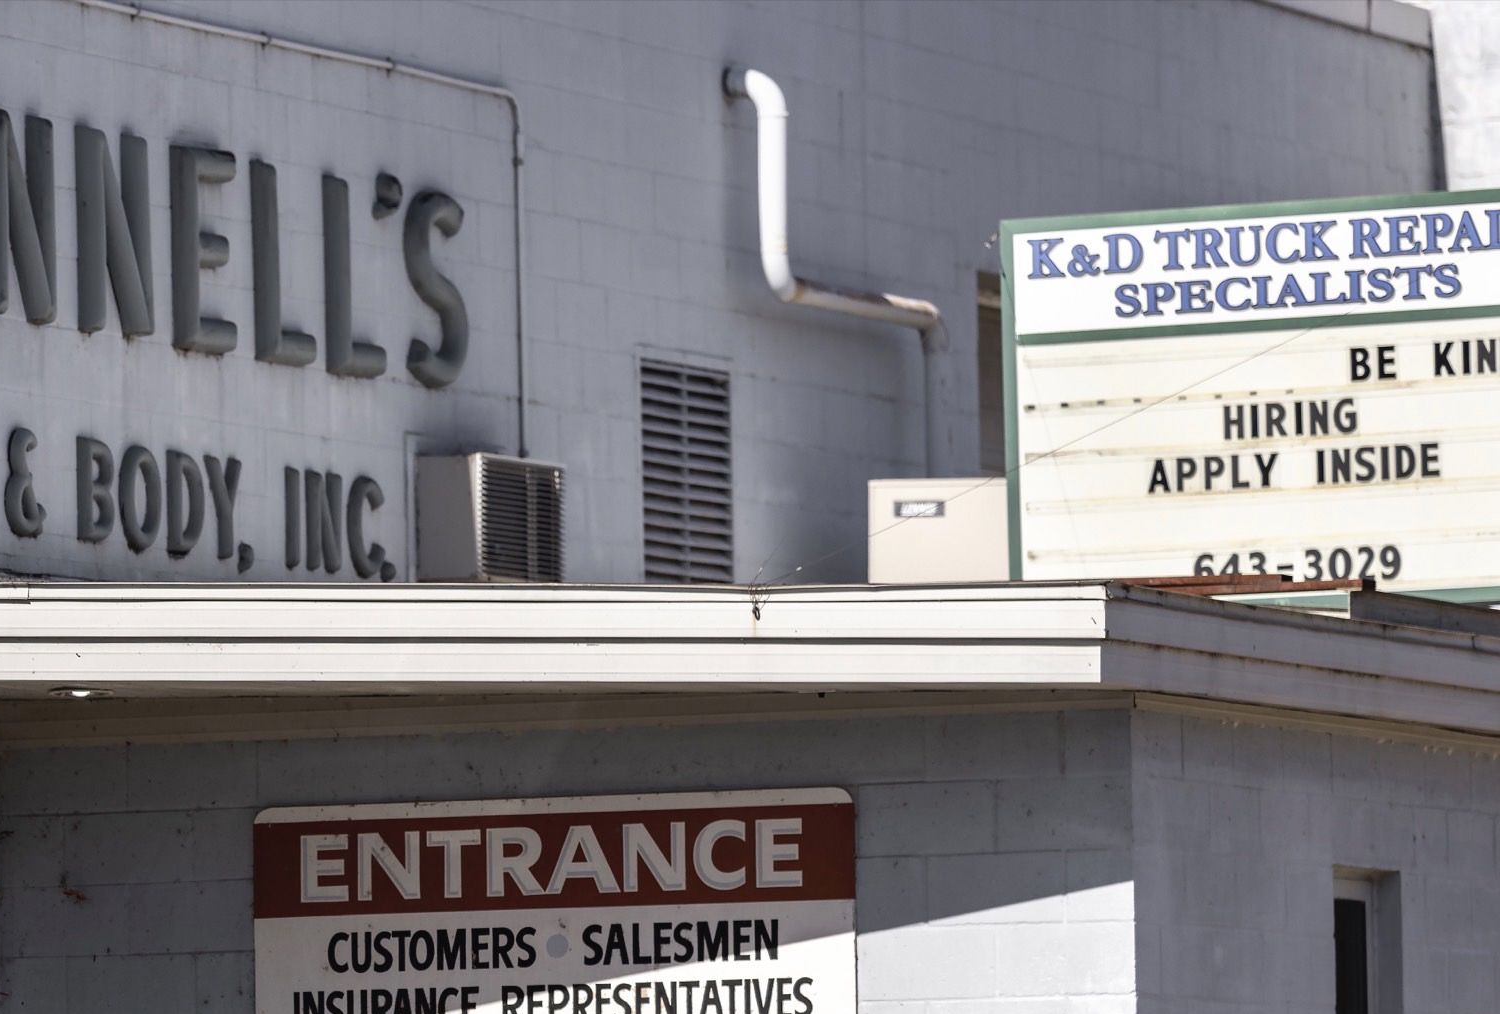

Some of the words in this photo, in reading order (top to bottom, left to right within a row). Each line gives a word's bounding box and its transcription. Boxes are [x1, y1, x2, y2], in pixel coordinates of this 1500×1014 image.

[1027, 233, 1144, 280] K&D
[1154, 219, 1340, 271] TRUCK
[1115, 263, 1463, 318] SPECIALISTS
[1349, 345, 1397, 382] BE
[1223, 398, 1358, 441] HIRING
[1148, 453, 1280, 494] APPLY
[1316, 443, 1441, 485] INSIDE
[4, 425, 47, 540] &
[284, 465, 397, 583] INC.
[1194, 545, 1402, 581] 643-3029
[300, 817, 803, 903] ENTRANCE
[327, 926, 537, 974] CUSTOMERS
[583, 919, 780, 966] SALESMEN
